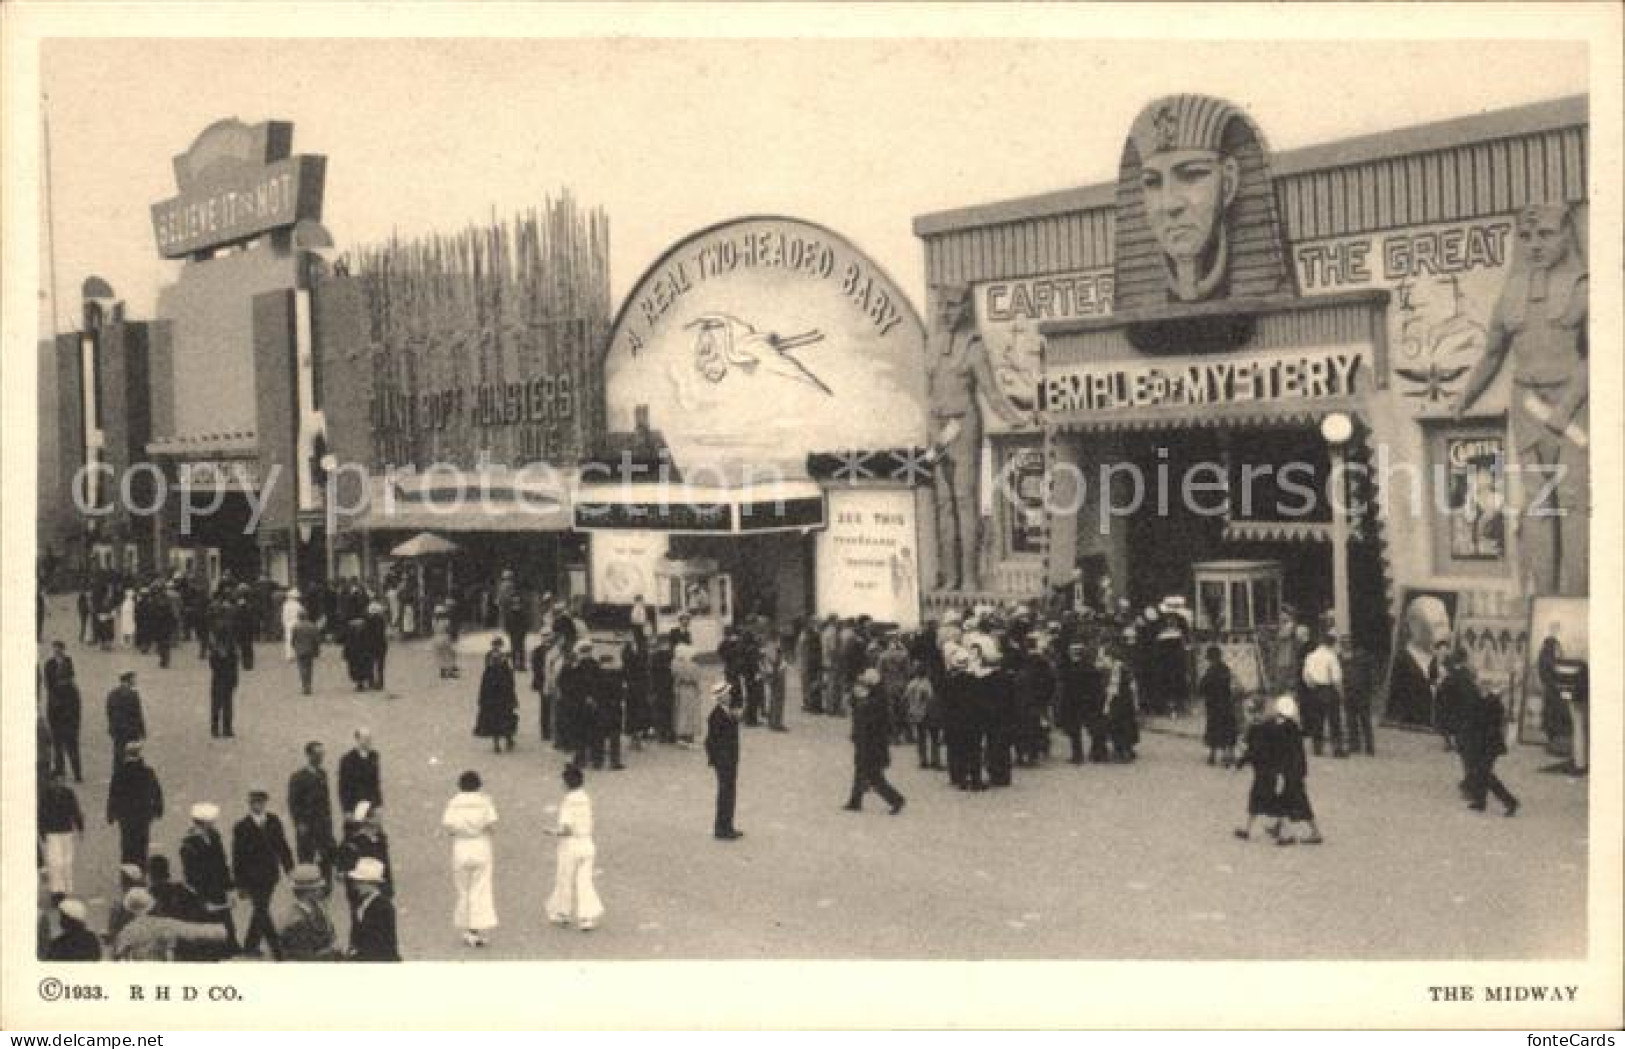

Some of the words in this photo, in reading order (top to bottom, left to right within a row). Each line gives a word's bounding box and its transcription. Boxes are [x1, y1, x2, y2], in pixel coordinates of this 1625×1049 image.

[257, 173, 292, 218] NOT
[640, 262, 694, 327] REAL
[692, 231, 835, 282] TWO-HEADED
[842, 262, 904, 338] BABY
[986, 275, 1115, 322] CARTER
[1301, 240, 1371, 288] THE
[1383, 223, 1511, 281] GREAT
[1036, 368, 1151, 413] TEMPLE
[1186, 351, 1363, 404] MYSTERY
